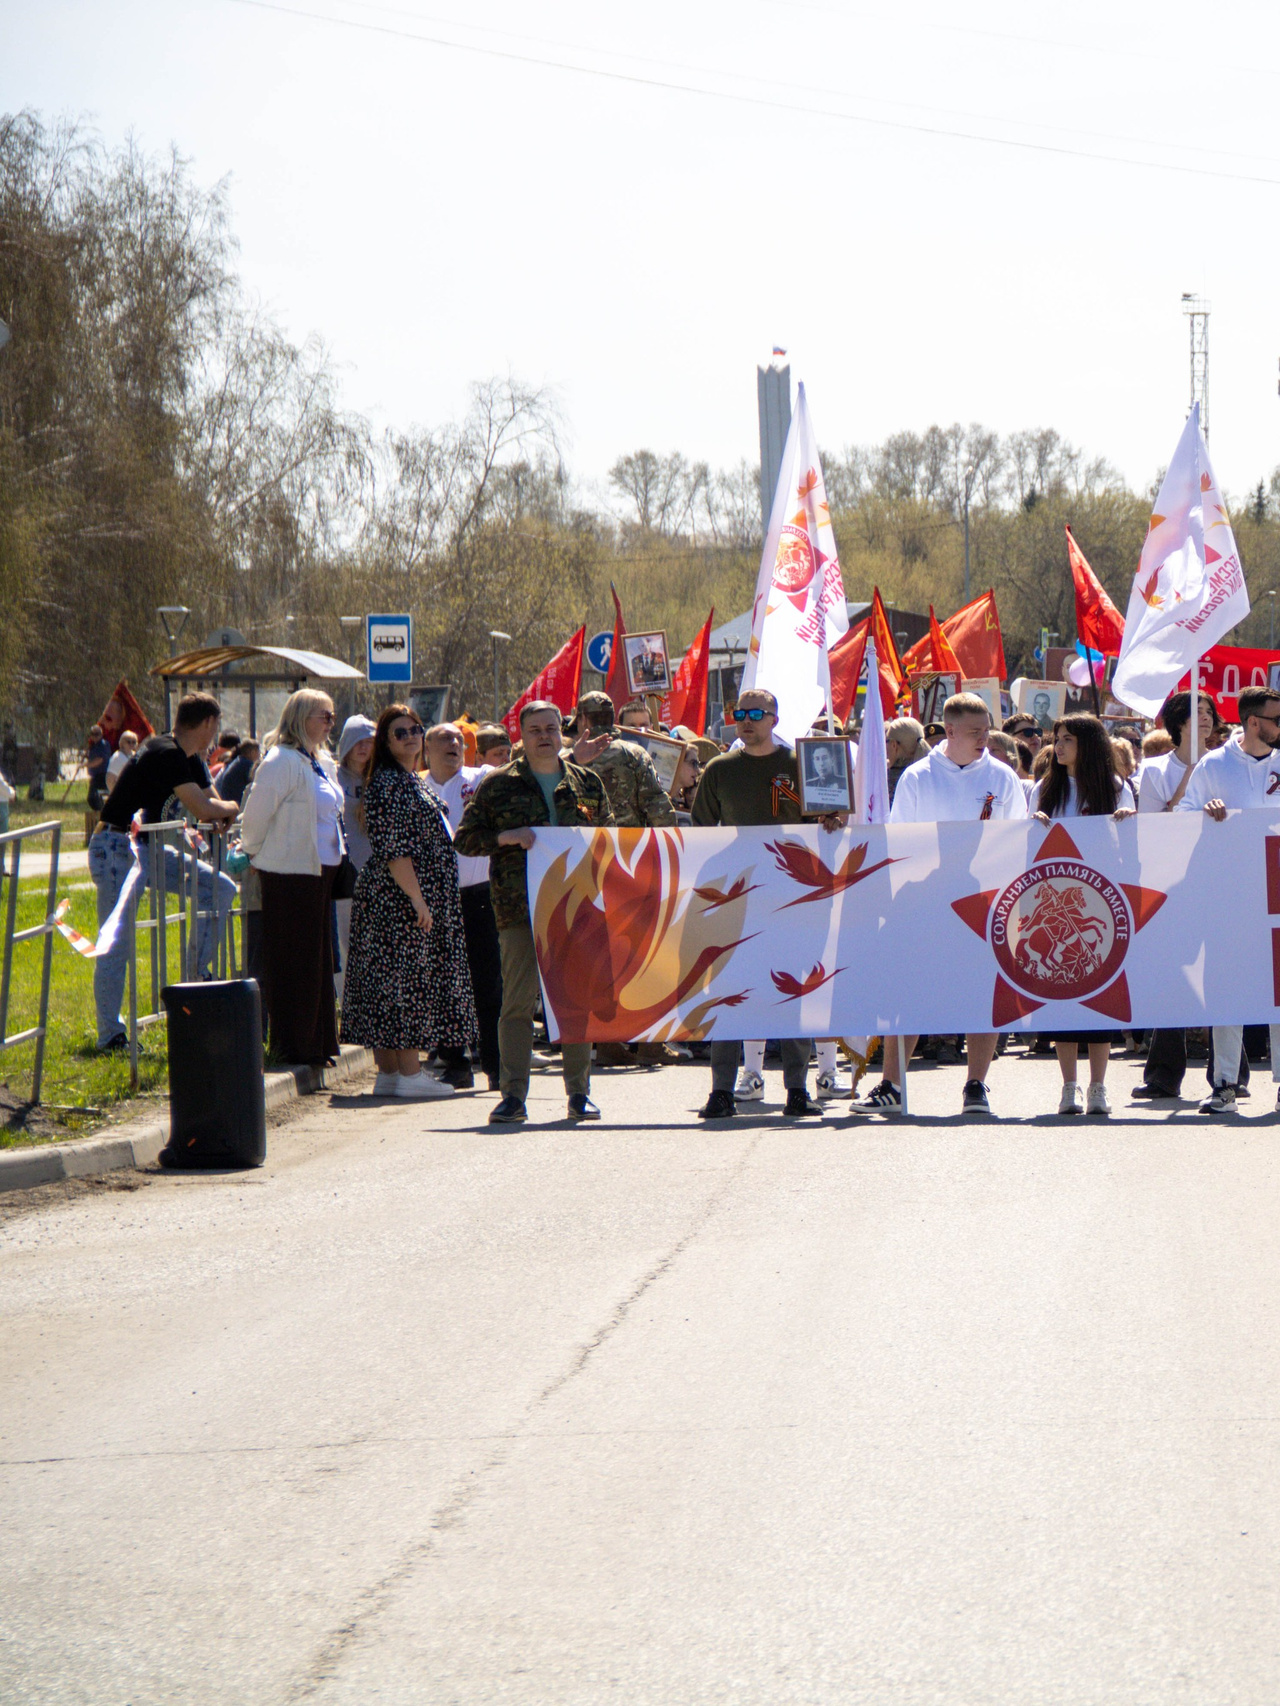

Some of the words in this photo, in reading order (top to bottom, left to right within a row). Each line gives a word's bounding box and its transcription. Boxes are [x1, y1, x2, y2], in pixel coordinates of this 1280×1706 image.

[993, 869, 1043, 945] СОХРАНЯЕМ
[1045, 864, 1102, 889] ПАМЯТЬ
[1102, 886, 1128, 941] ВМЕСТЕ
